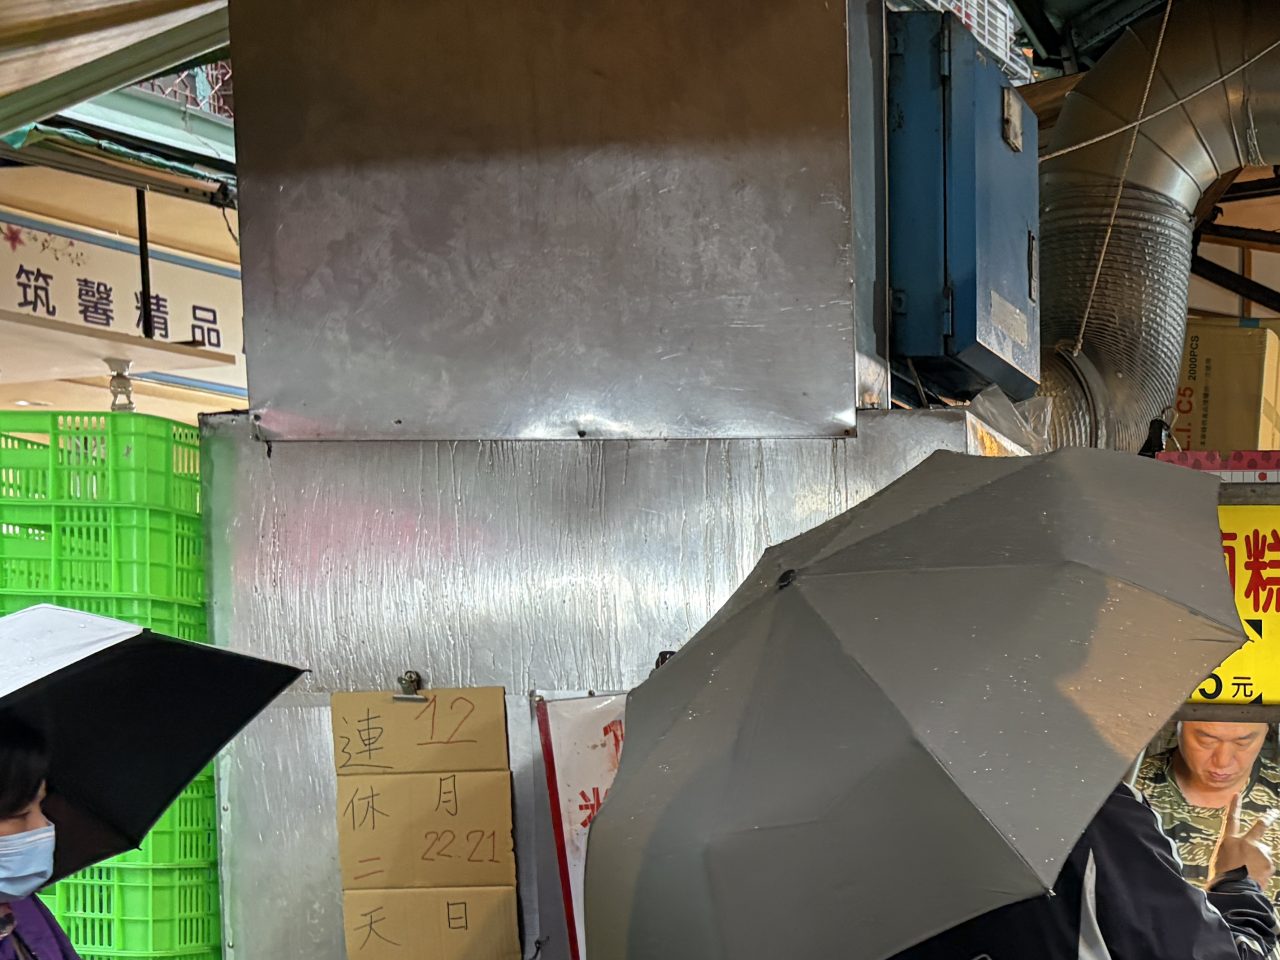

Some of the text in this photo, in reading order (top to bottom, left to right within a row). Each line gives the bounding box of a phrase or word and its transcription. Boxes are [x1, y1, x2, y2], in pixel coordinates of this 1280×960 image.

[16, 264, 221, 348] 筑馨精品
[1176, 386, 1194, 415] C5
[1188, 335, 1200, 381] 2000PCS
